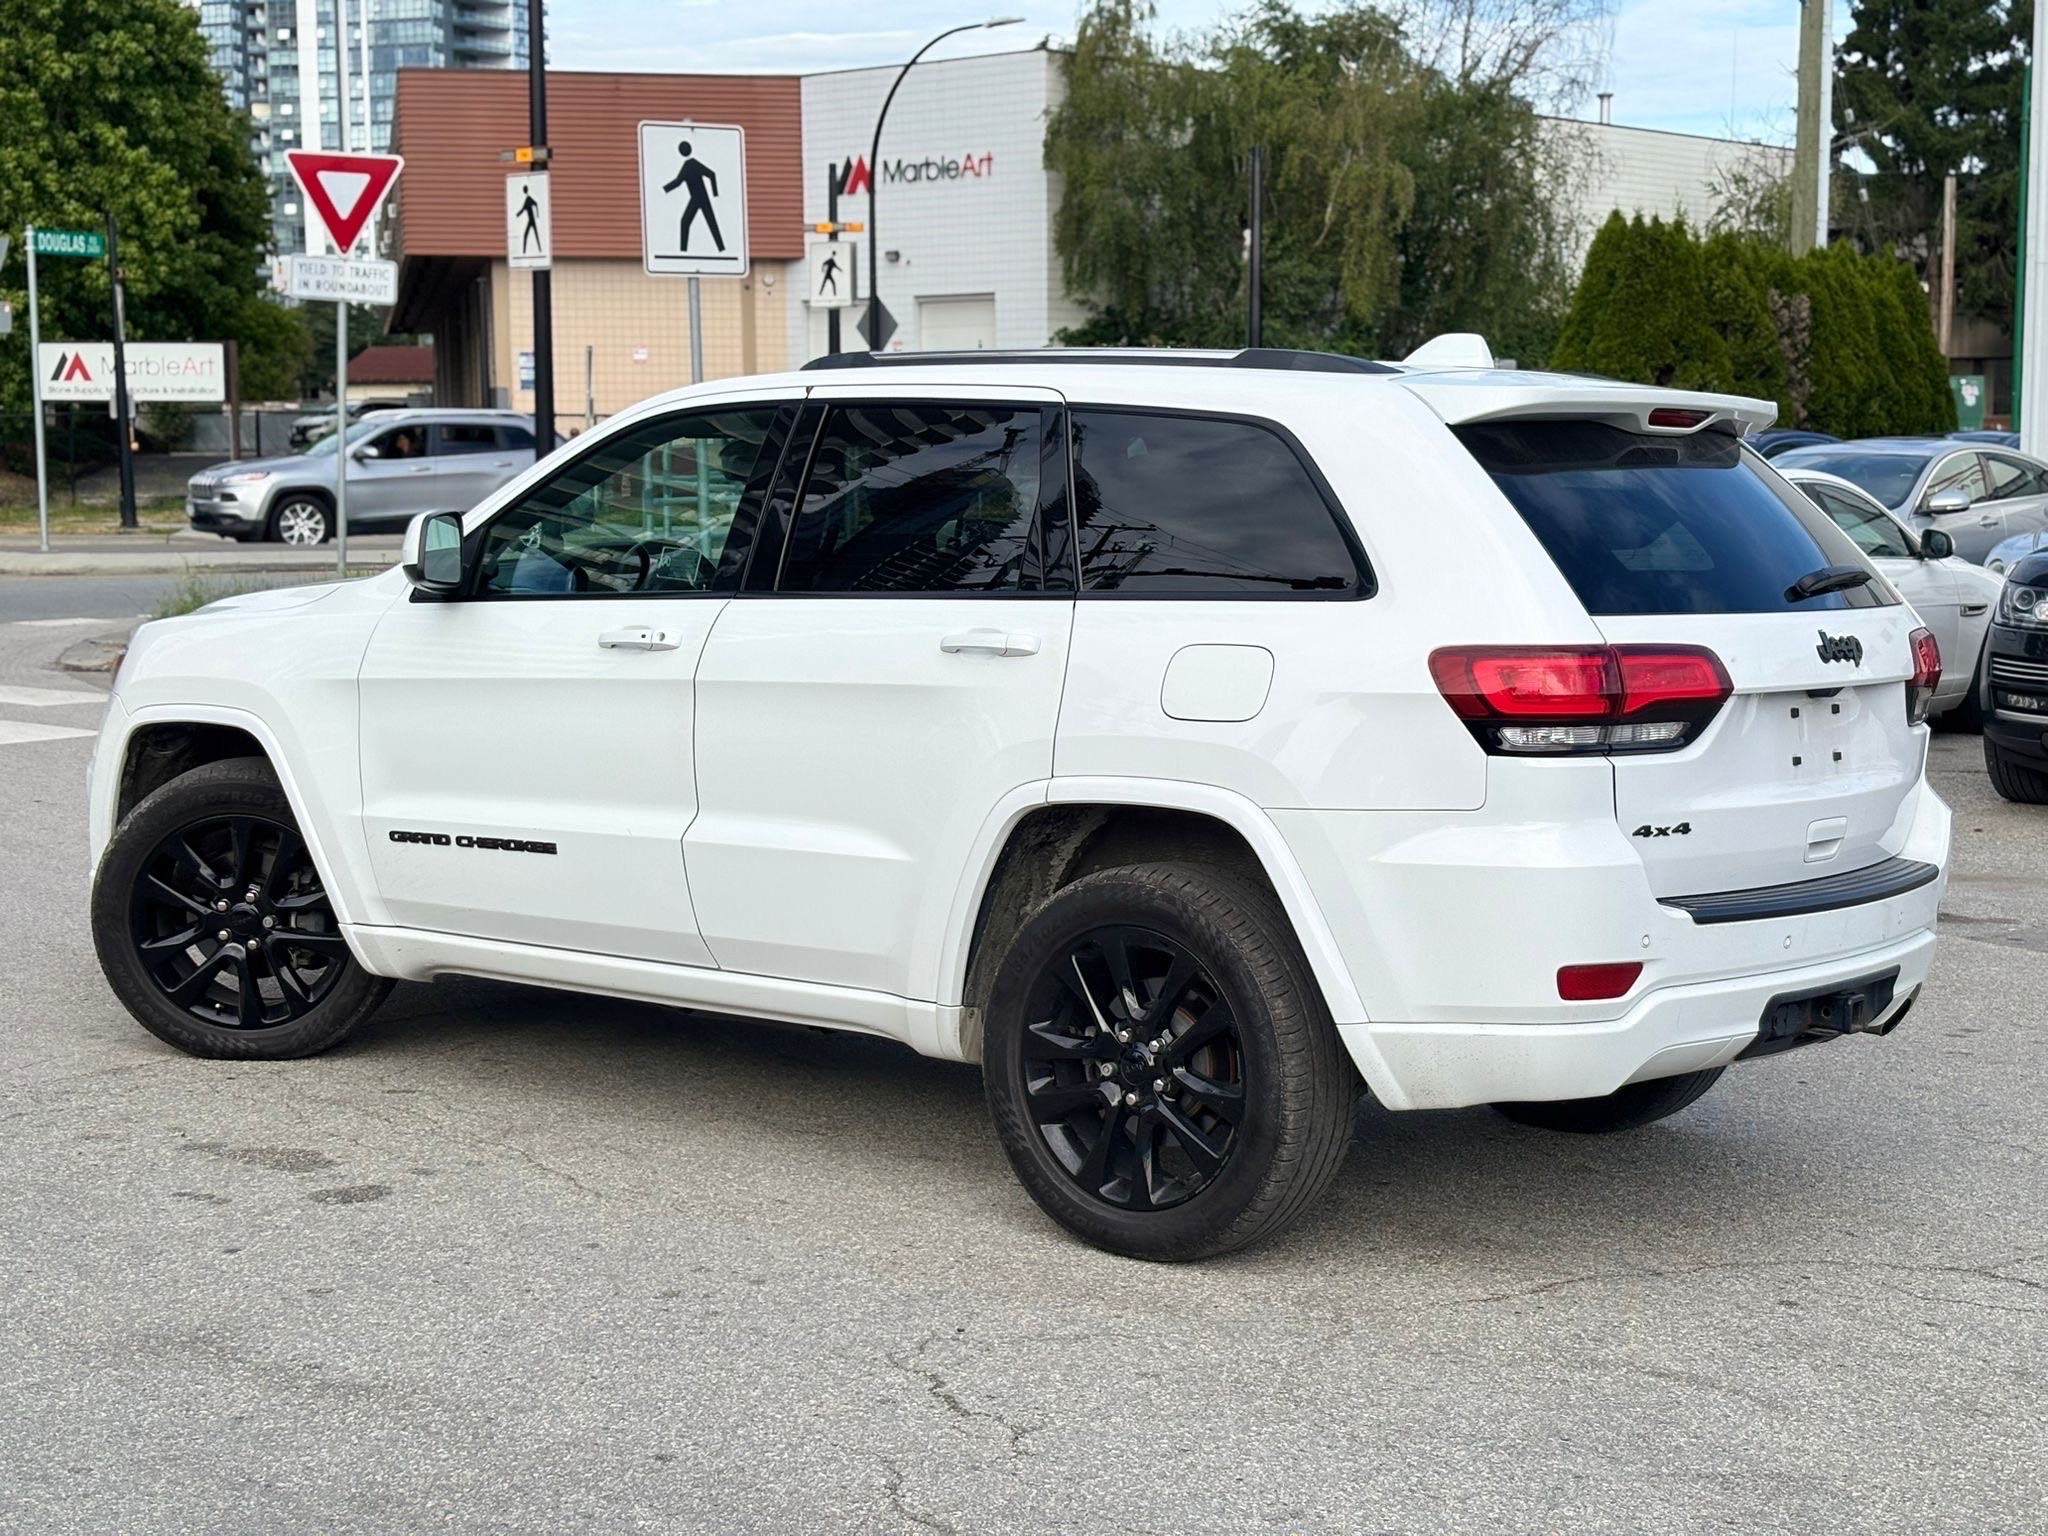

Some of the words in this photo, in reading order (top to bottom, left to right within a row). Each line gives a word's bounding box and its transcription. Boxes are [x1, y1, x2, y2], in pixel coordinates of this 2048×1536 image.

[882, 151, 994, 184] MarbleArt
[37, 232, 86, 253] DOUGLAS
[299, 263, 327, 275] YIELD
[332, 264, 345, 277] TO
[350, 266, 390, 280] TRAFFIC
[299, 279, 309, 289] IN
[316, 280, 389, 297] ROUNDABOUT
[1815, 629, 1863, 668] Jeep
[1632, 822, 1692, 838] 4x4
[389, 830, 451, 846] GRAND
[455, 835, 558, 855] CHEROKEE
